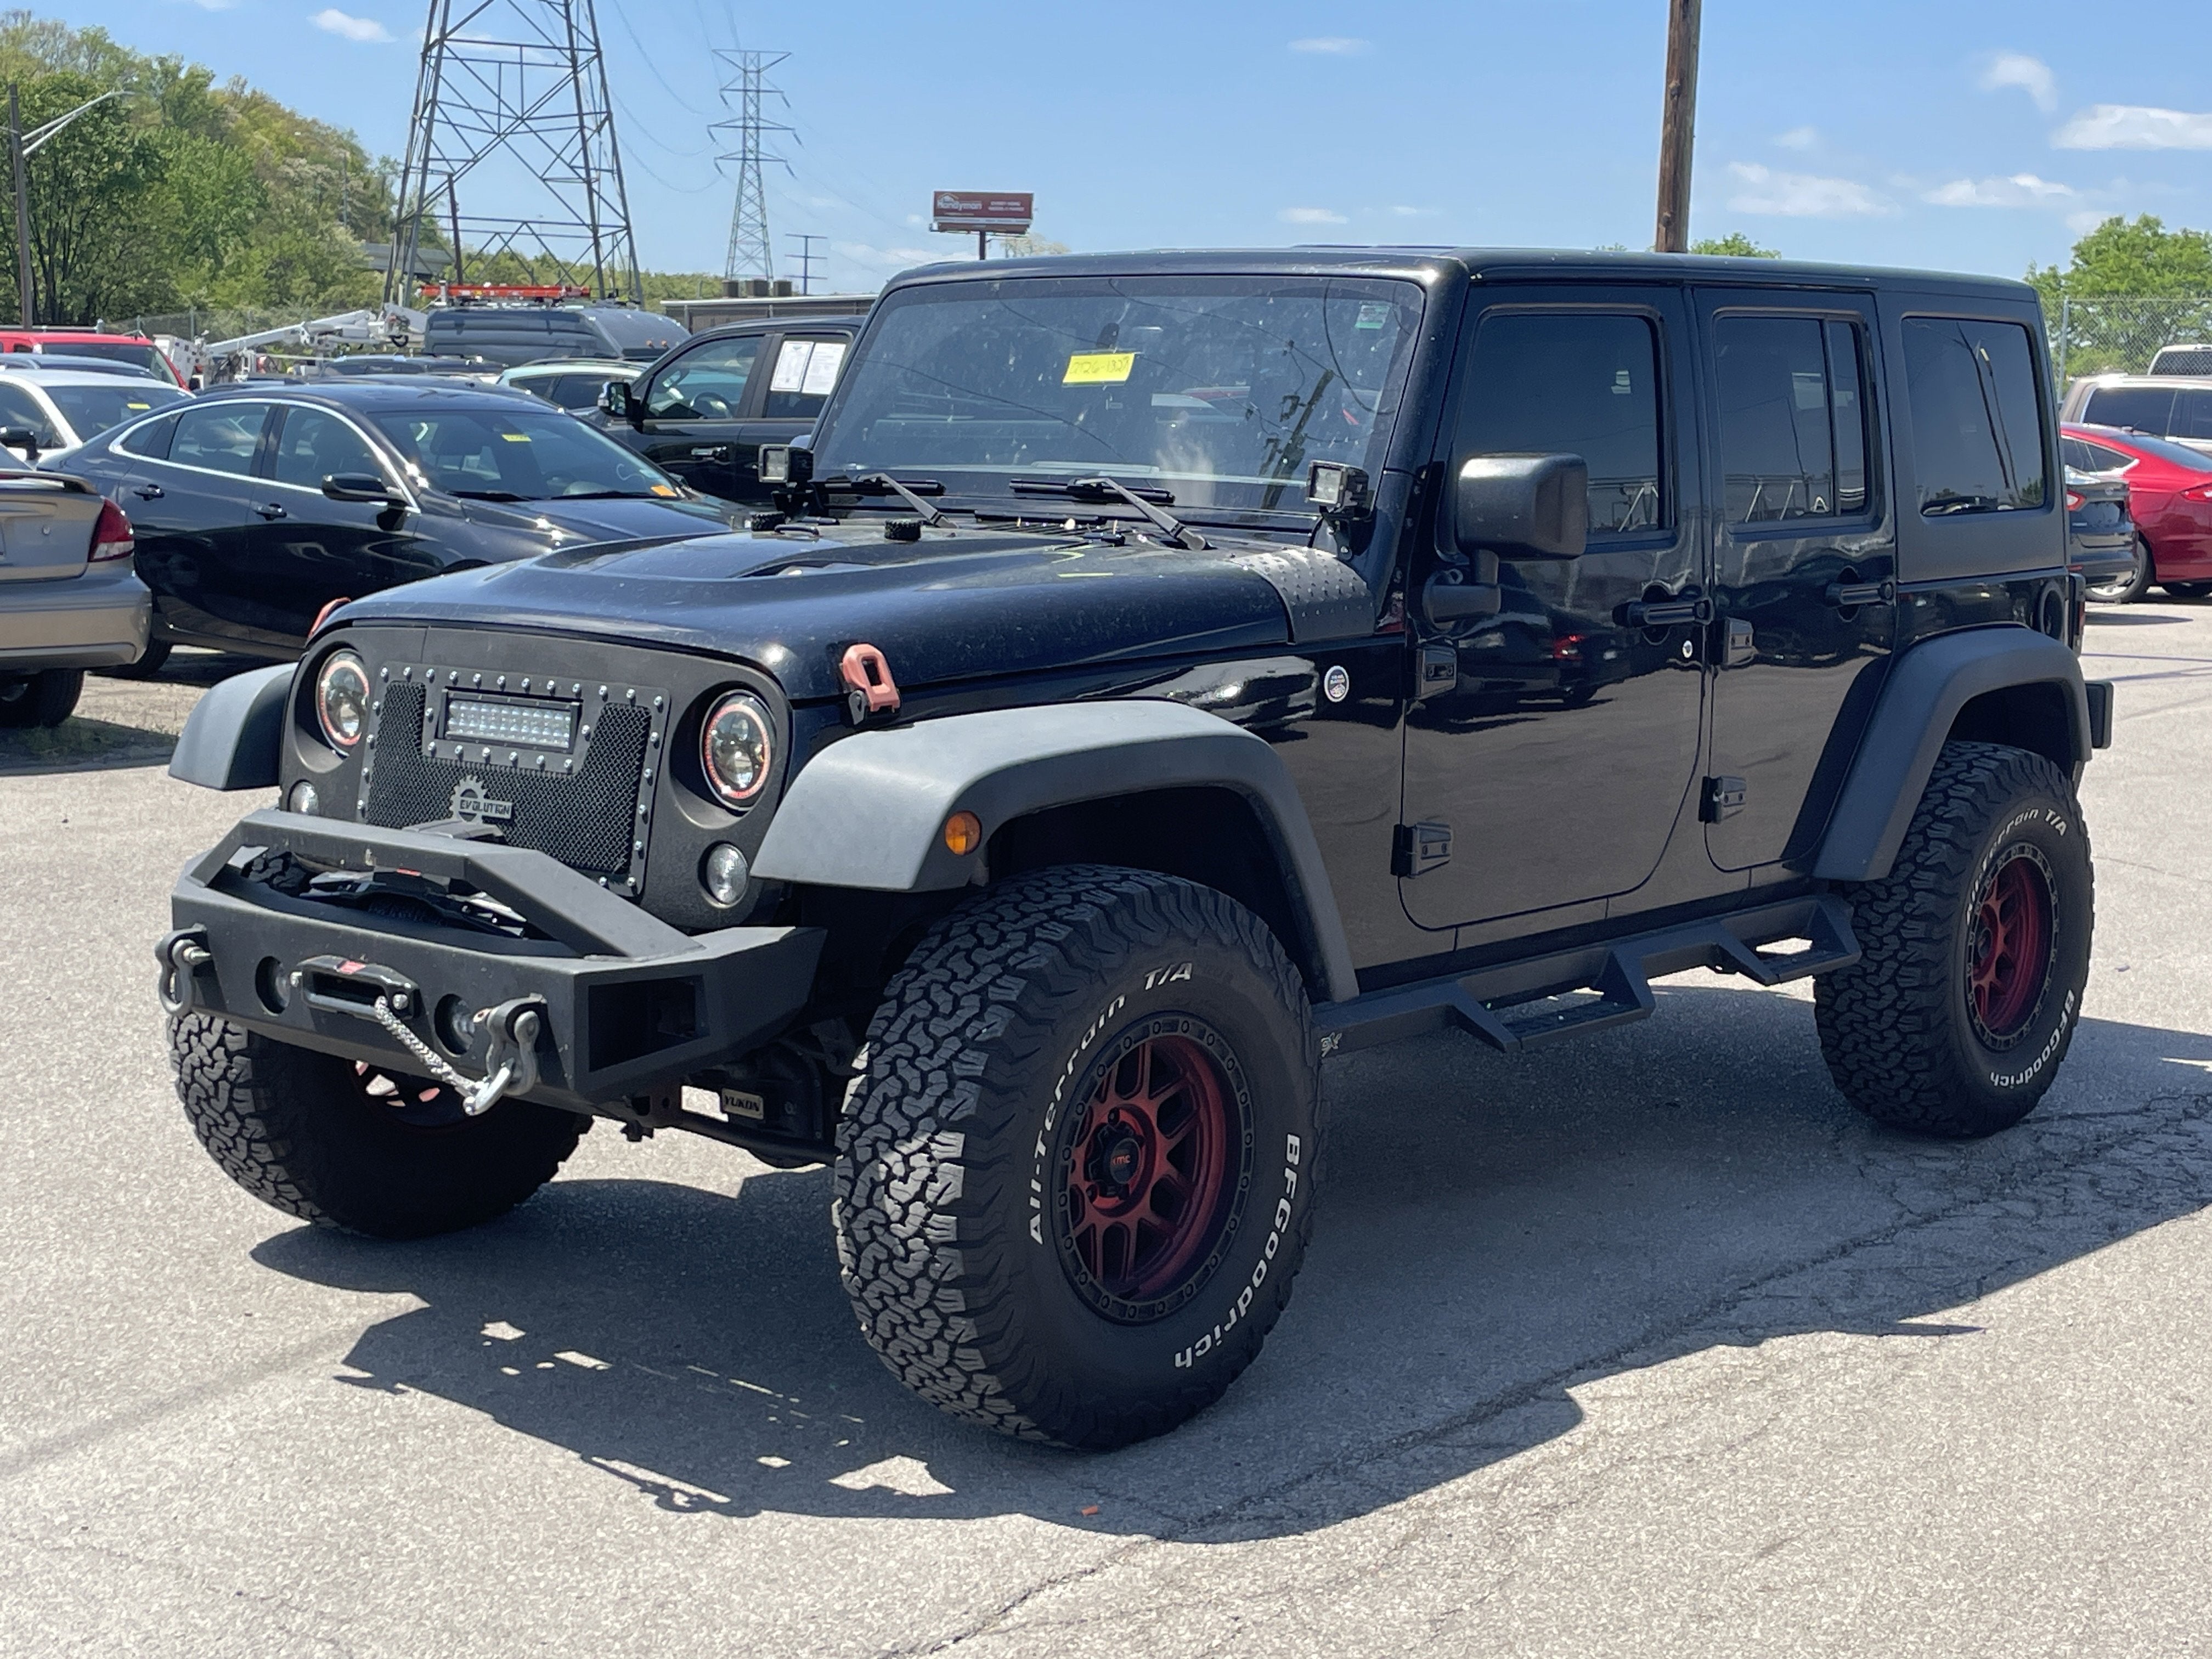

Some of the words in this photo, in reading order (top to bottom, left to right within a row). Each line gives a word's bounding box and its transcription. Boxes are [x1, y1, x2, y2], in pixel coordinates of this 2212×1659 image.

[460, 799, 511, 815] EVOLUTION
[2045, 809, 2067, 837] T/A
[1990, 989, 2075, 1090] BFGoodrich
[724, 1094, 760, 1112] YUKON
[1030, 994, 1126, 1245] All-Terrain
[1144, 962, 1193, 991] T/A
[1174, 1133, 1301, 1368] BFGoodrich
